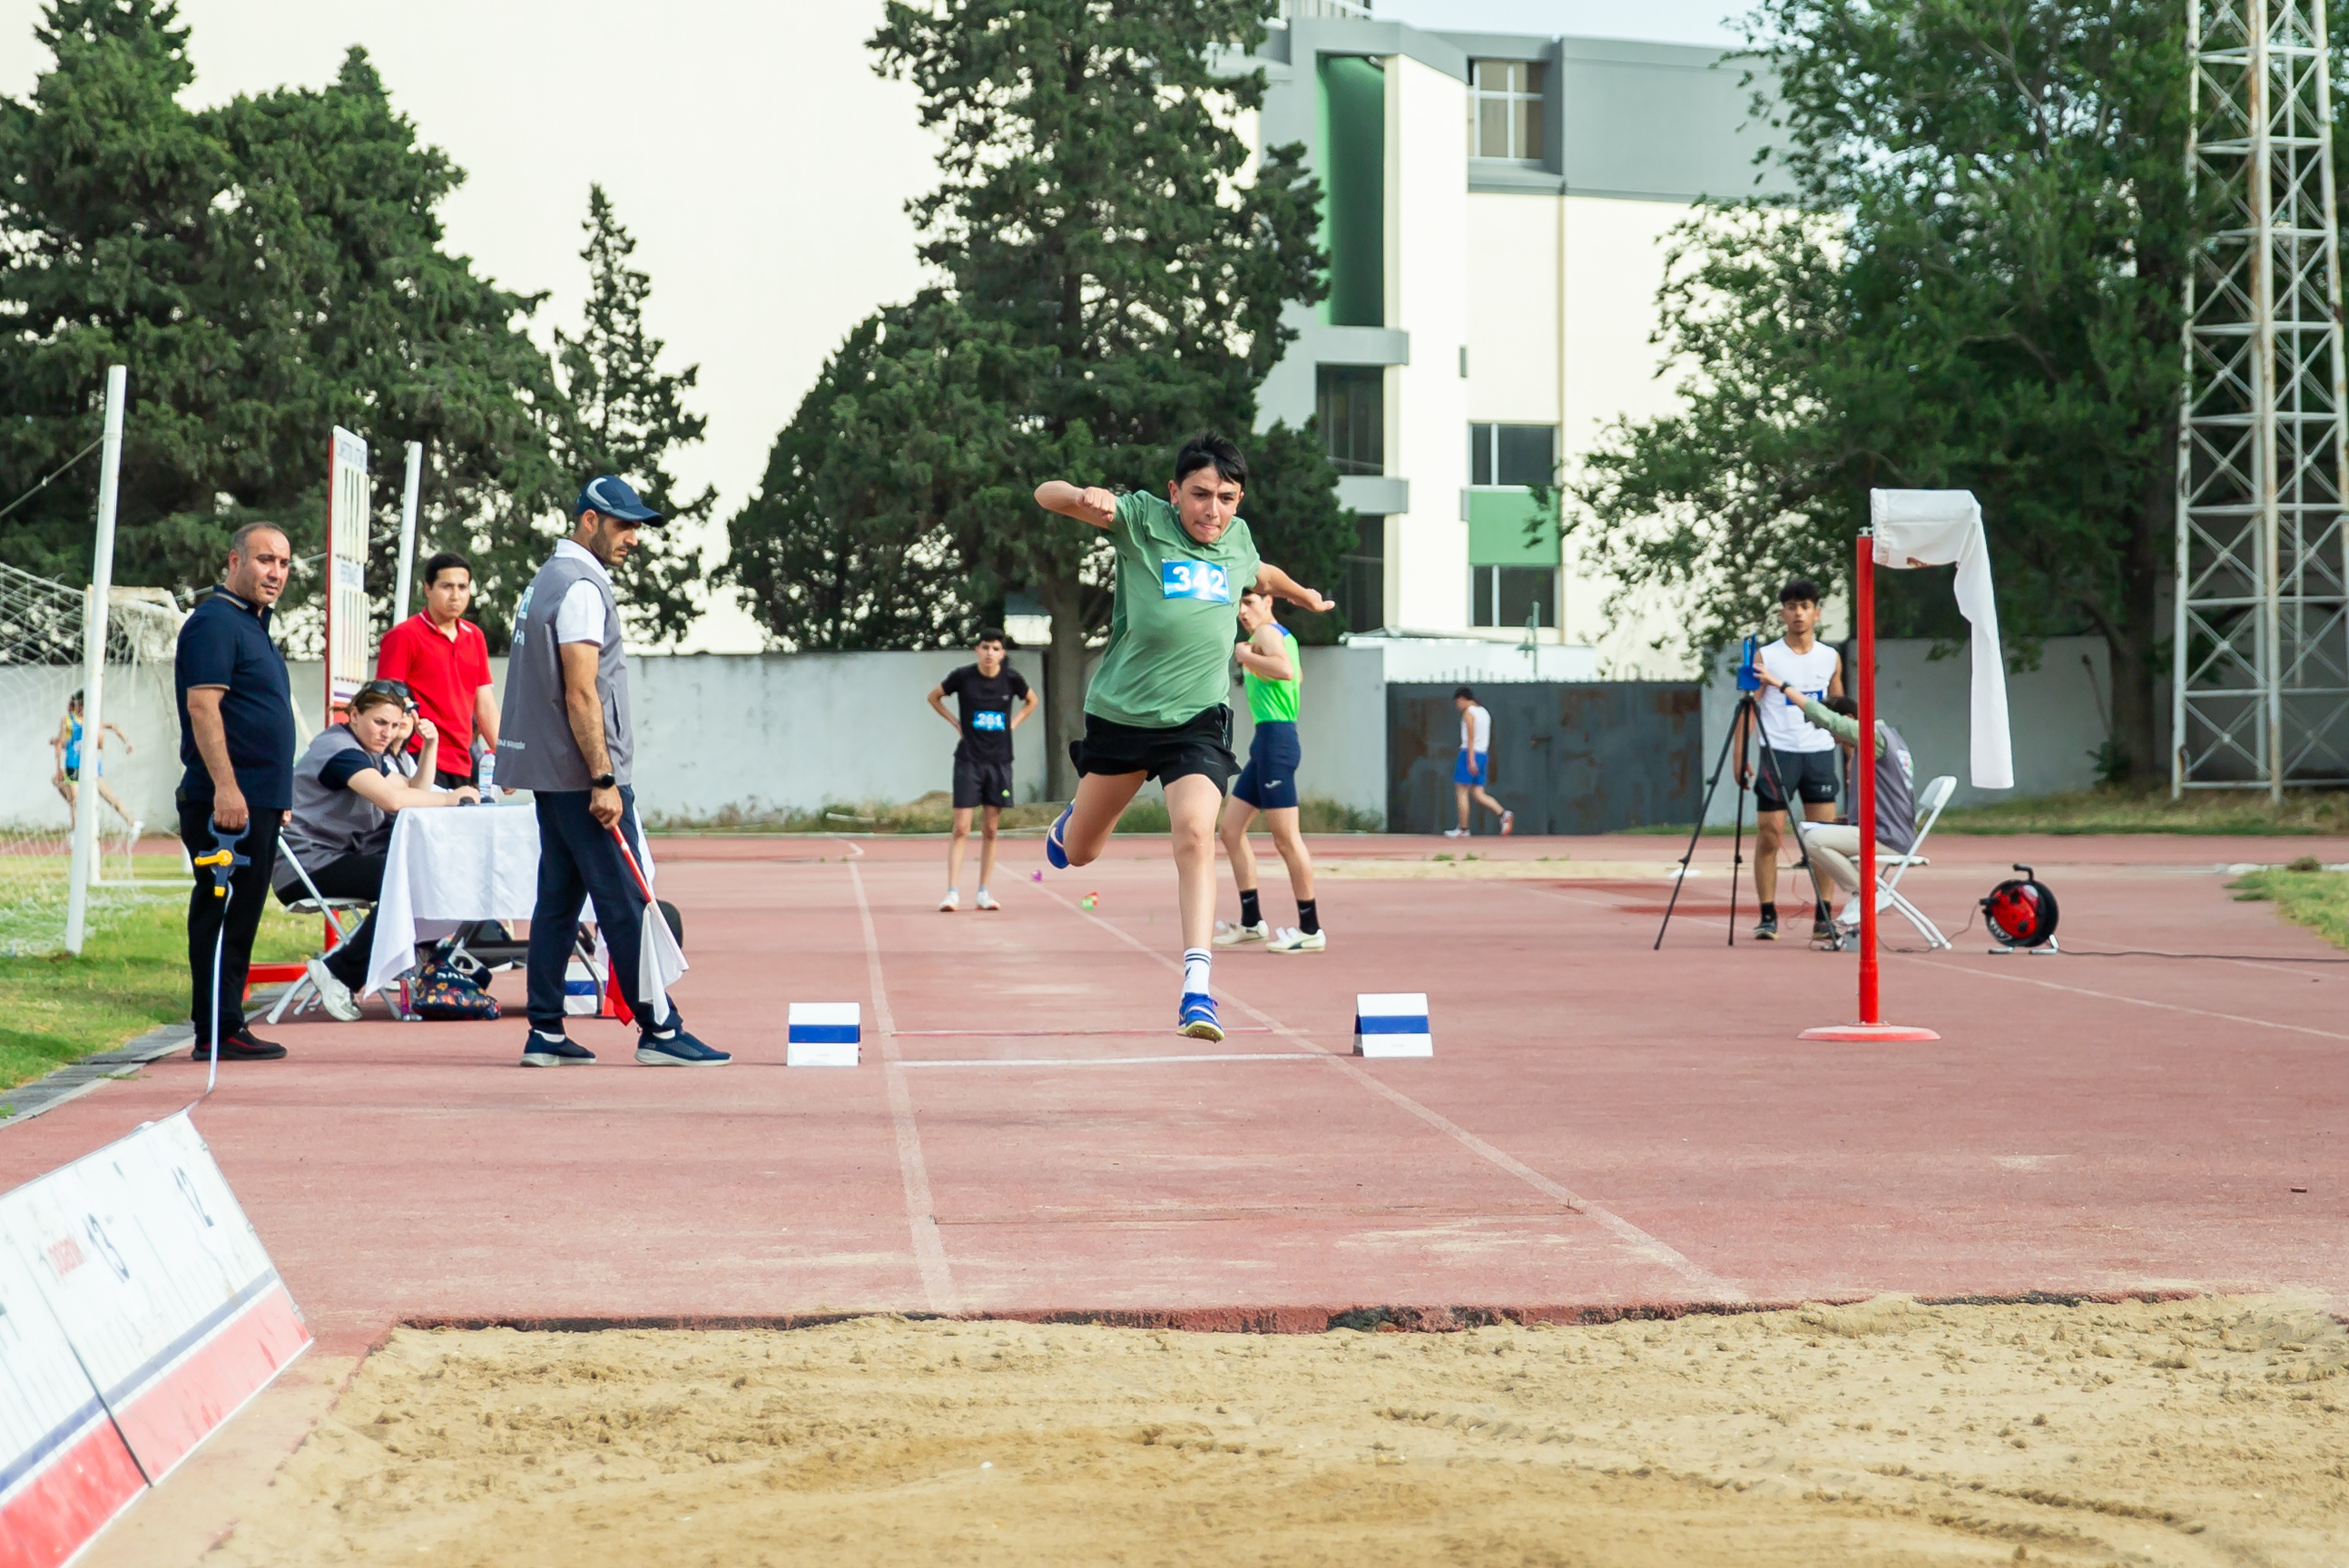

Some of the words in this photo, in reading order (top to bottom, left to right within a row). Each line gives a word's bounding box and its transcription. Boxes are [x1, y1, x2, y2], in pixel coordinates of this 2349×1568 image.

[1172, 565, 1227, 596] 342
[172, 1165, 214, 1228] 12
[81, 1212, 130, 1284] 13
